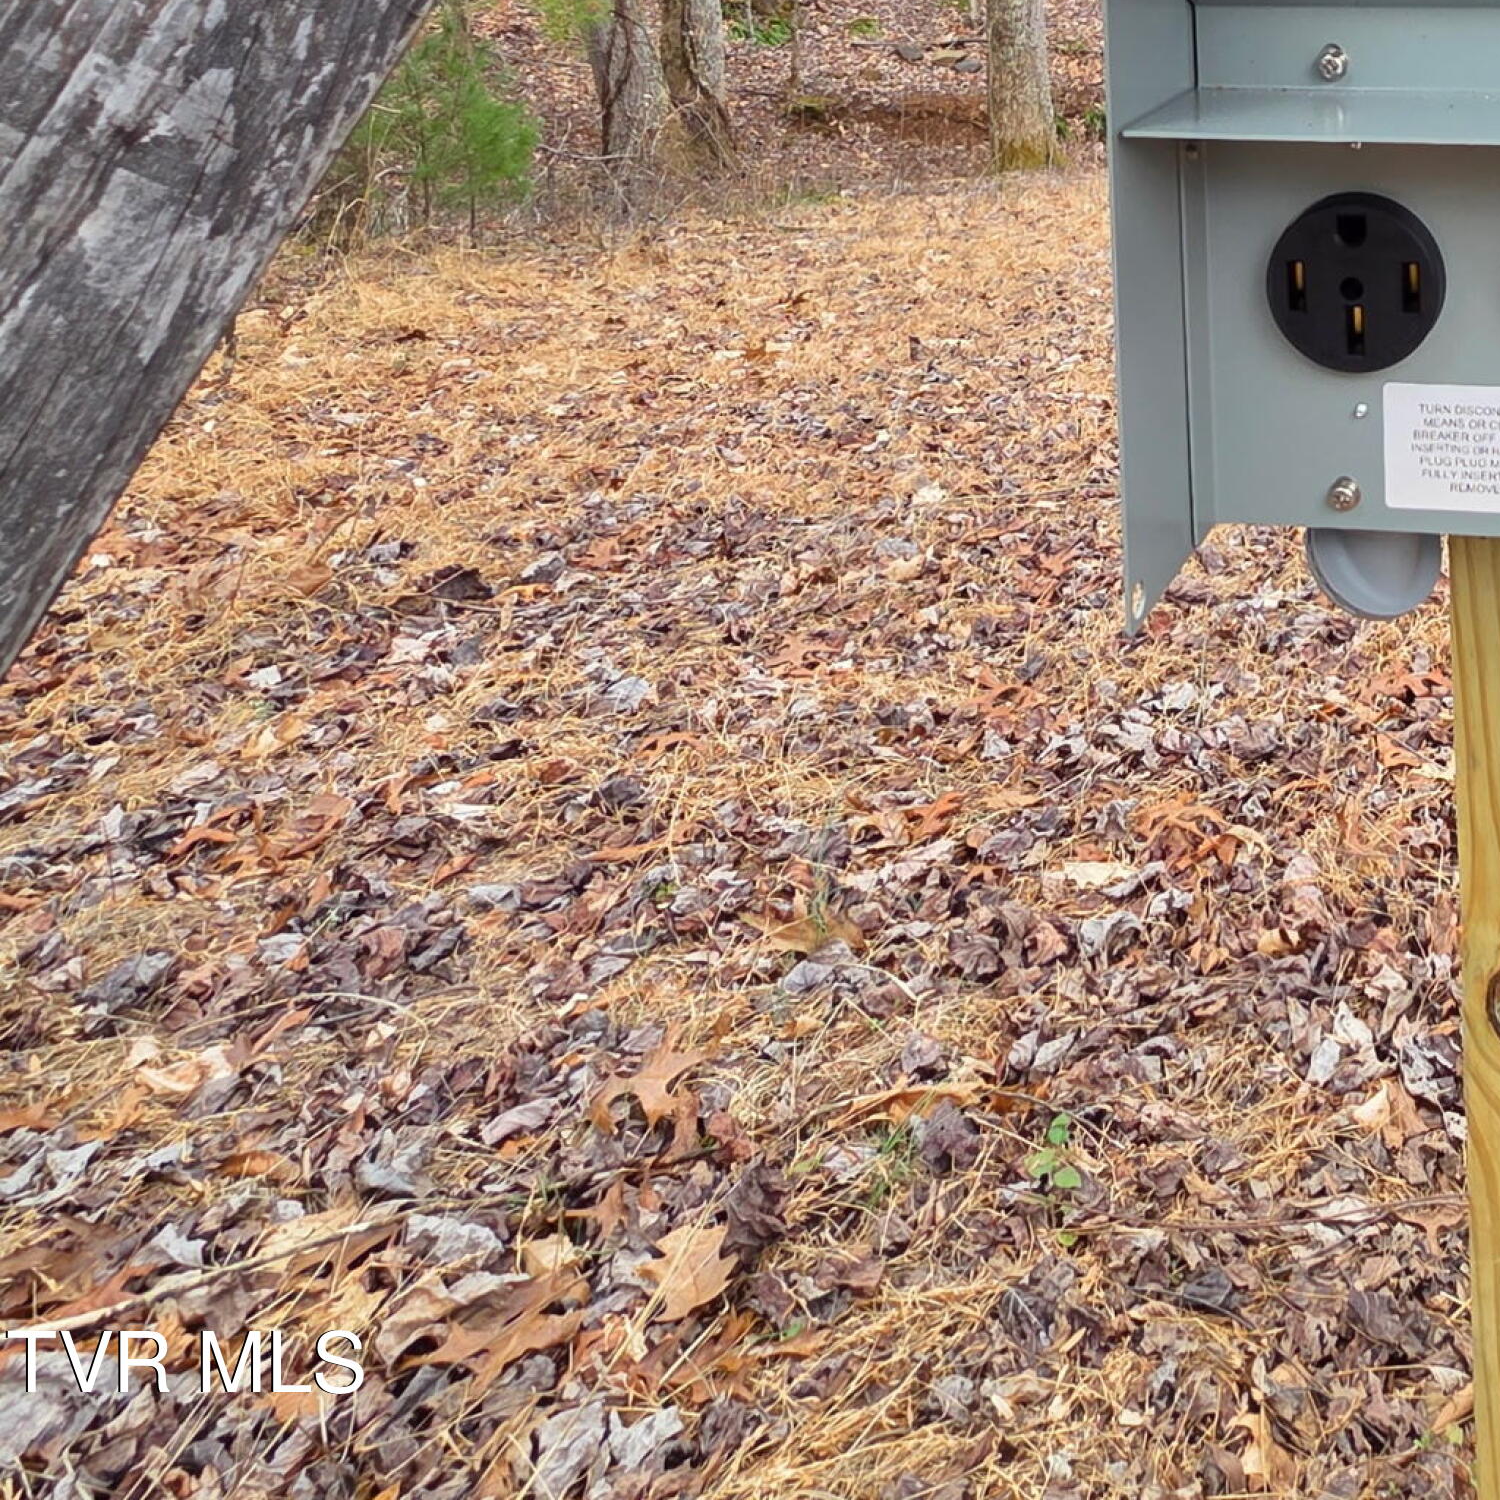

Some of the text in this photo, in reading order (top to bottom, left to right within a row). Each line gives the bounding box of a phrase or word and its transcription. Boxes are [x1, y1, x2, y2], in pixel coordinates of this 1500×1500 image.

[1419, 403, 1451, 414] TURN
[1423, 418, 1465, 428] MEANS
[1468, 419, 1485, 430] OR
[1413, 430, 1469, 442] BREAKER
[1473, 433, 1498, 443] OFF
[1411, 443, 1470, 454] INSERTING
[1473, 446, 1488, 455] OR
[1419, 456, 1451, 467] PLUG
[1455, 457, 1487, 468] PLUG
[1422, 468, 1457, 479] FULLY
